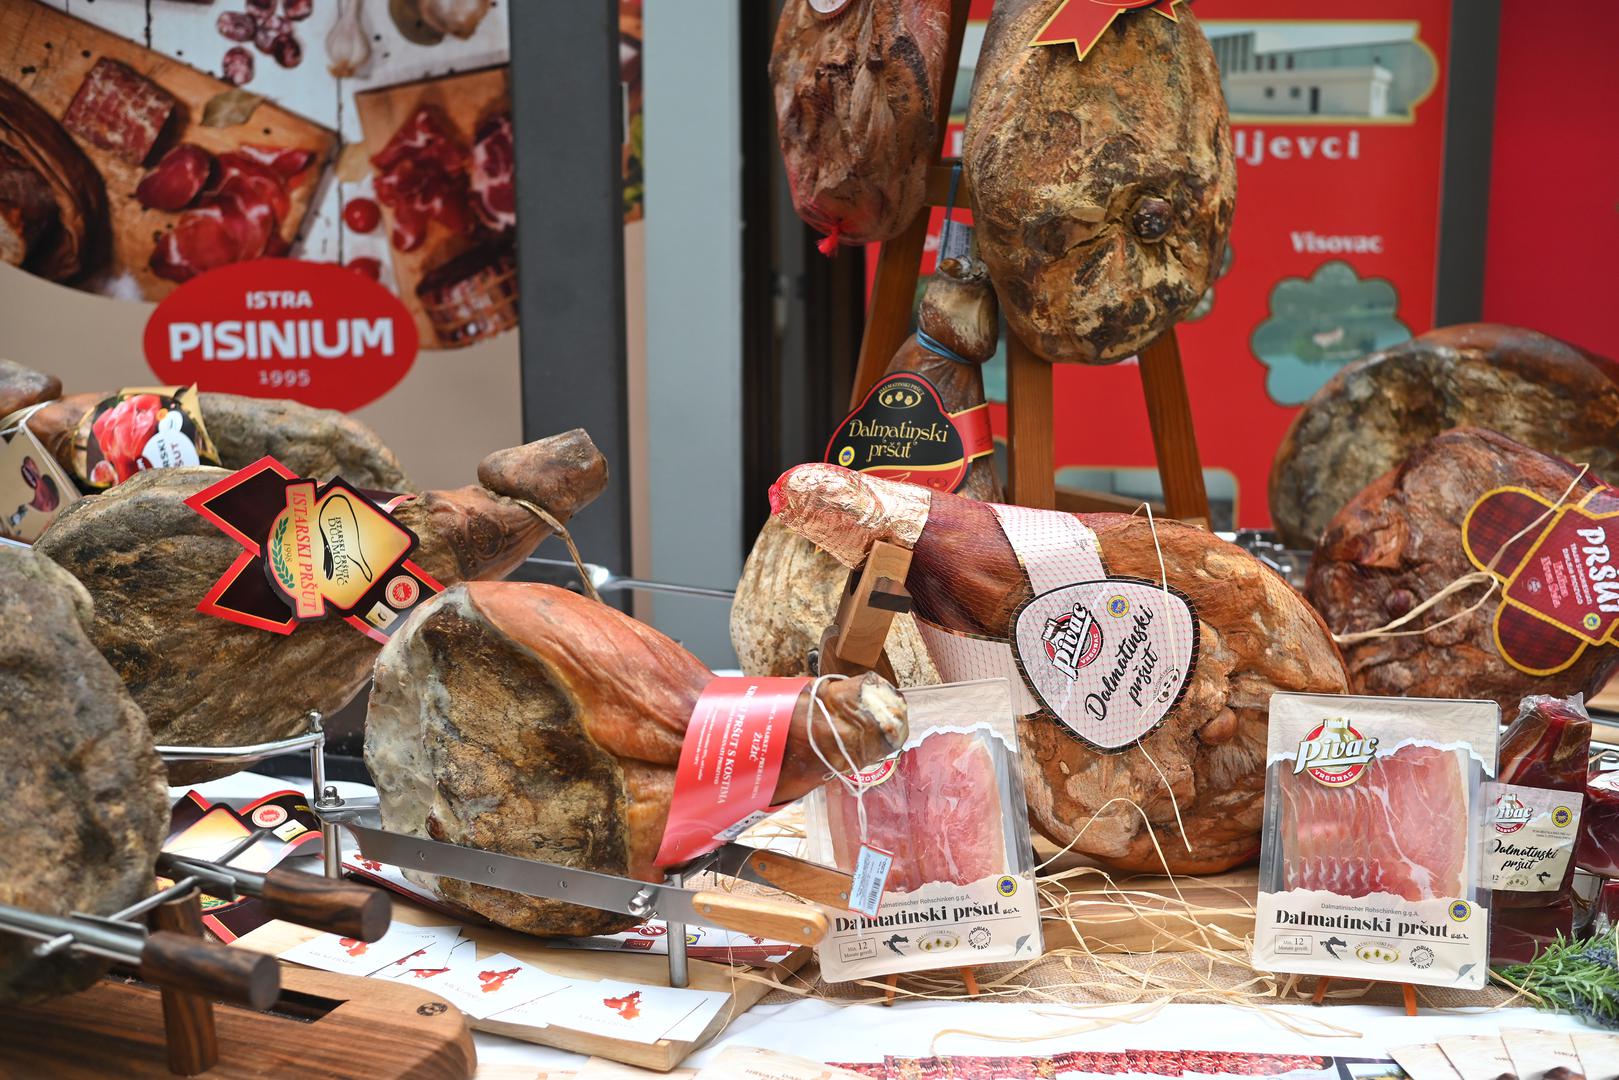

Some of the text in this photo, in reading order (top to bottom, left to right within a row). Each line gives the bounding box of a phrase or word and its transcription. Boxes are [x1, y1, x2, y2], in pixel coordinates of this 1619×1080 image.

[1235, 130, 1360, 166] ljevci
[1290, 231, 1383, 254] Visovac
[246, 290, 313, 309] ISTRA
[168, 317, 395, 362] PISINIUM
[259, 370, 310, 387] 1995
[848, 419, 949, 446] Dalmatinski
[866, 441, 913, 463] pršut
[292, 492, 319, 612] ISTARSKI PRŠUT
[328, 517, 348, 586] DUJMOVIĆ
[1085, 604, 1154, 721] Dalmatinski
[1128, 642, 1159, 707] pršut
[729, 714, 745, 748] PRŠUT
[727, 749, 736, 757] S
[749, 731, 763, 762] ŽUŽIĆ
[717, 759, 735, 804] KOSTIMA
[1315, 769, 1354, 782] VRGORAC
[1501, 858, 1538, 871] pršut
[953, 901, 1001, 922] pršut
[1321, 903, 1364, 912] Dalmatinischer
[1364, 906, 1402, 915] Rohschinken
[970, 926, 992, 936] ADRIATIC
[1275, 909, 1391, 932] Dalmatinski
[1397, 920, 1448, 937] pršut
[858, 942, 868, 950] 12
[977, 942, 990, 950] SALT
[1294, 937, 1304, 945] 12
[1413, 945, 1435, 958] ADRIATIC
[1417, 962, 1432, 970] SALT
